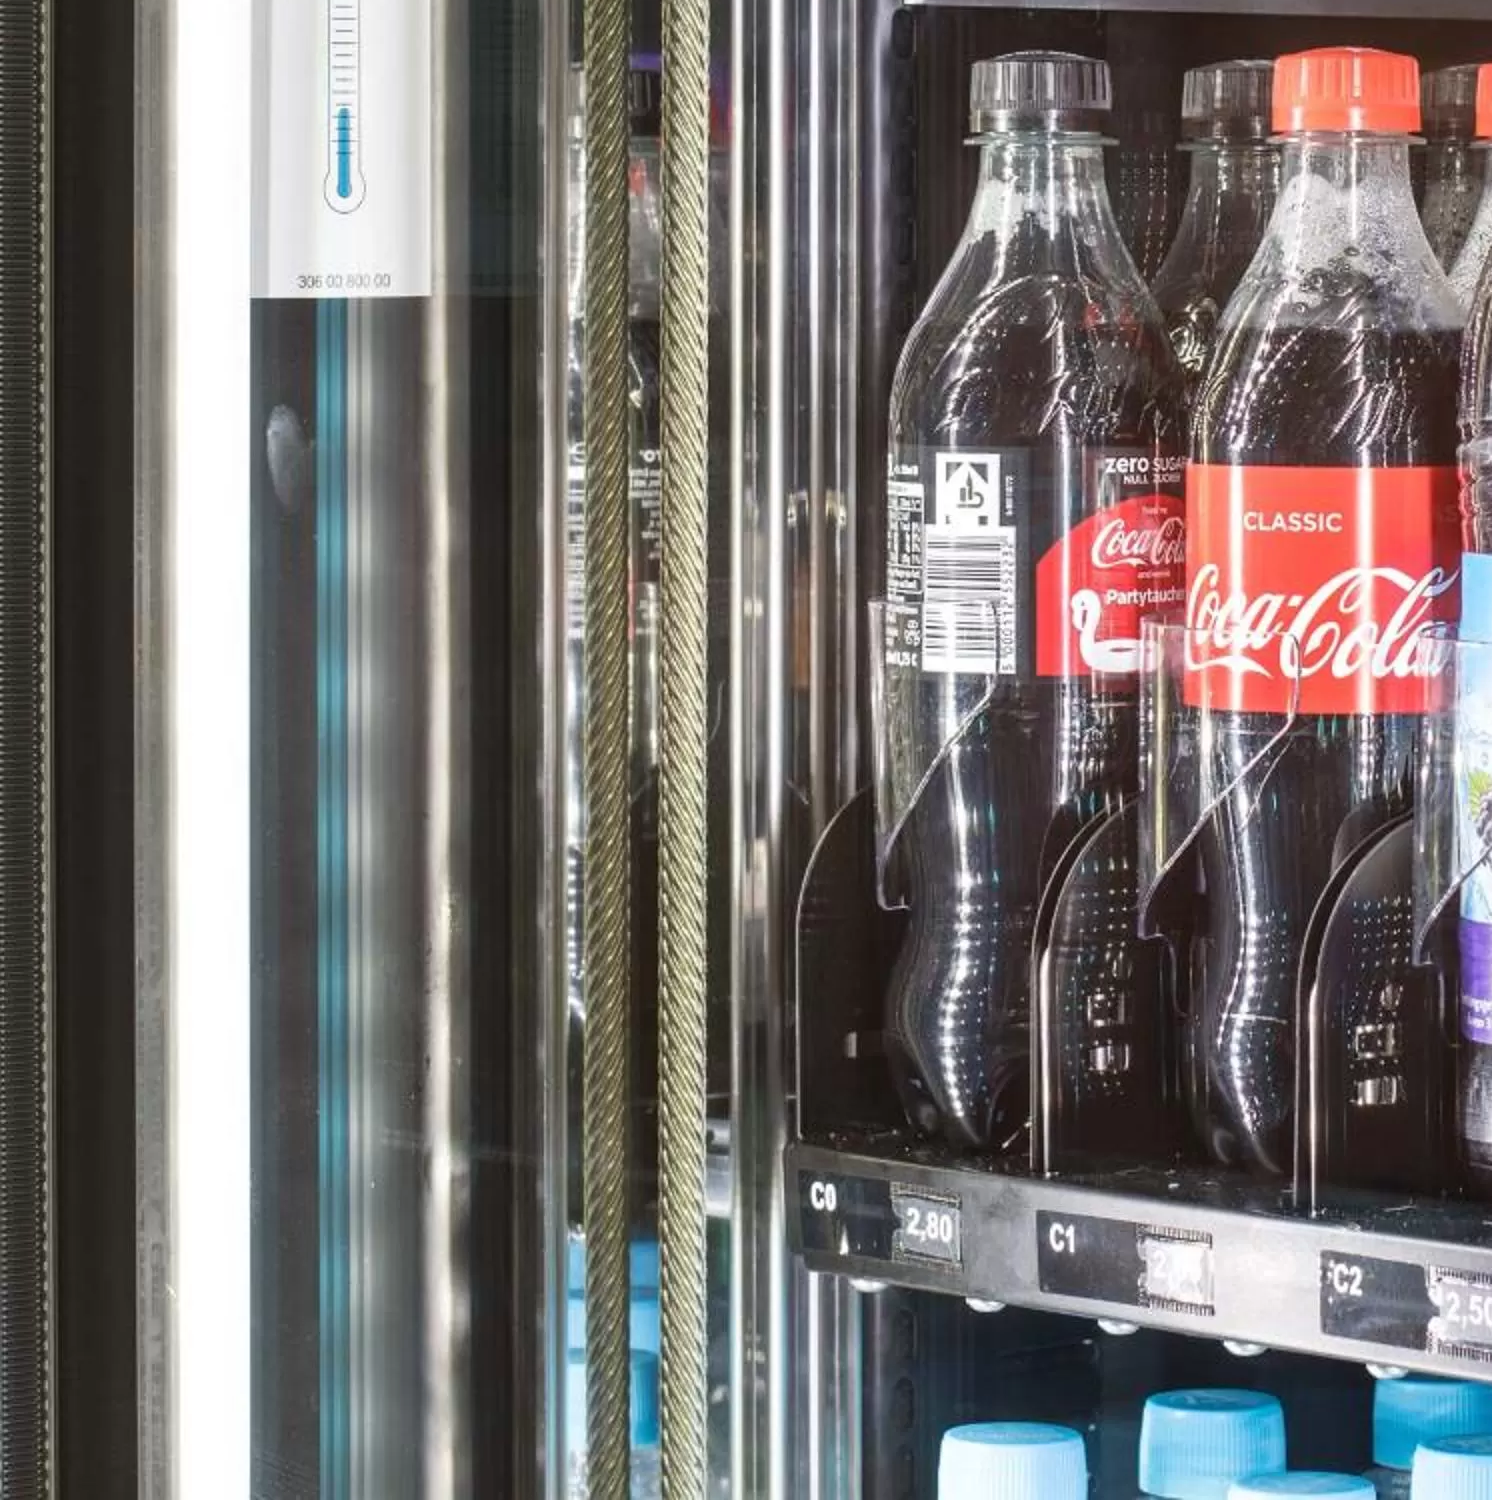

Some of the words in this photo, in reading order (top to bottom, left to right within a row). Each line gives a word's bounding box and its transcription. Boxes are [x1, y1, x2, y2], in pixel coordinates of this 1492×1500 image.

[1105, 456, 1149, 474] zero
[1242, 511, 1343, 533] CLASSIC
[1185, 563, 1460, 678] Coca-Cola
[810, 1182, 836, 1212] C0
[906, 1208, 953, 1244] 2,80
[1049, 1224, 1075, 1254] C1
[1333, 1265, 1362, 1297] C2
